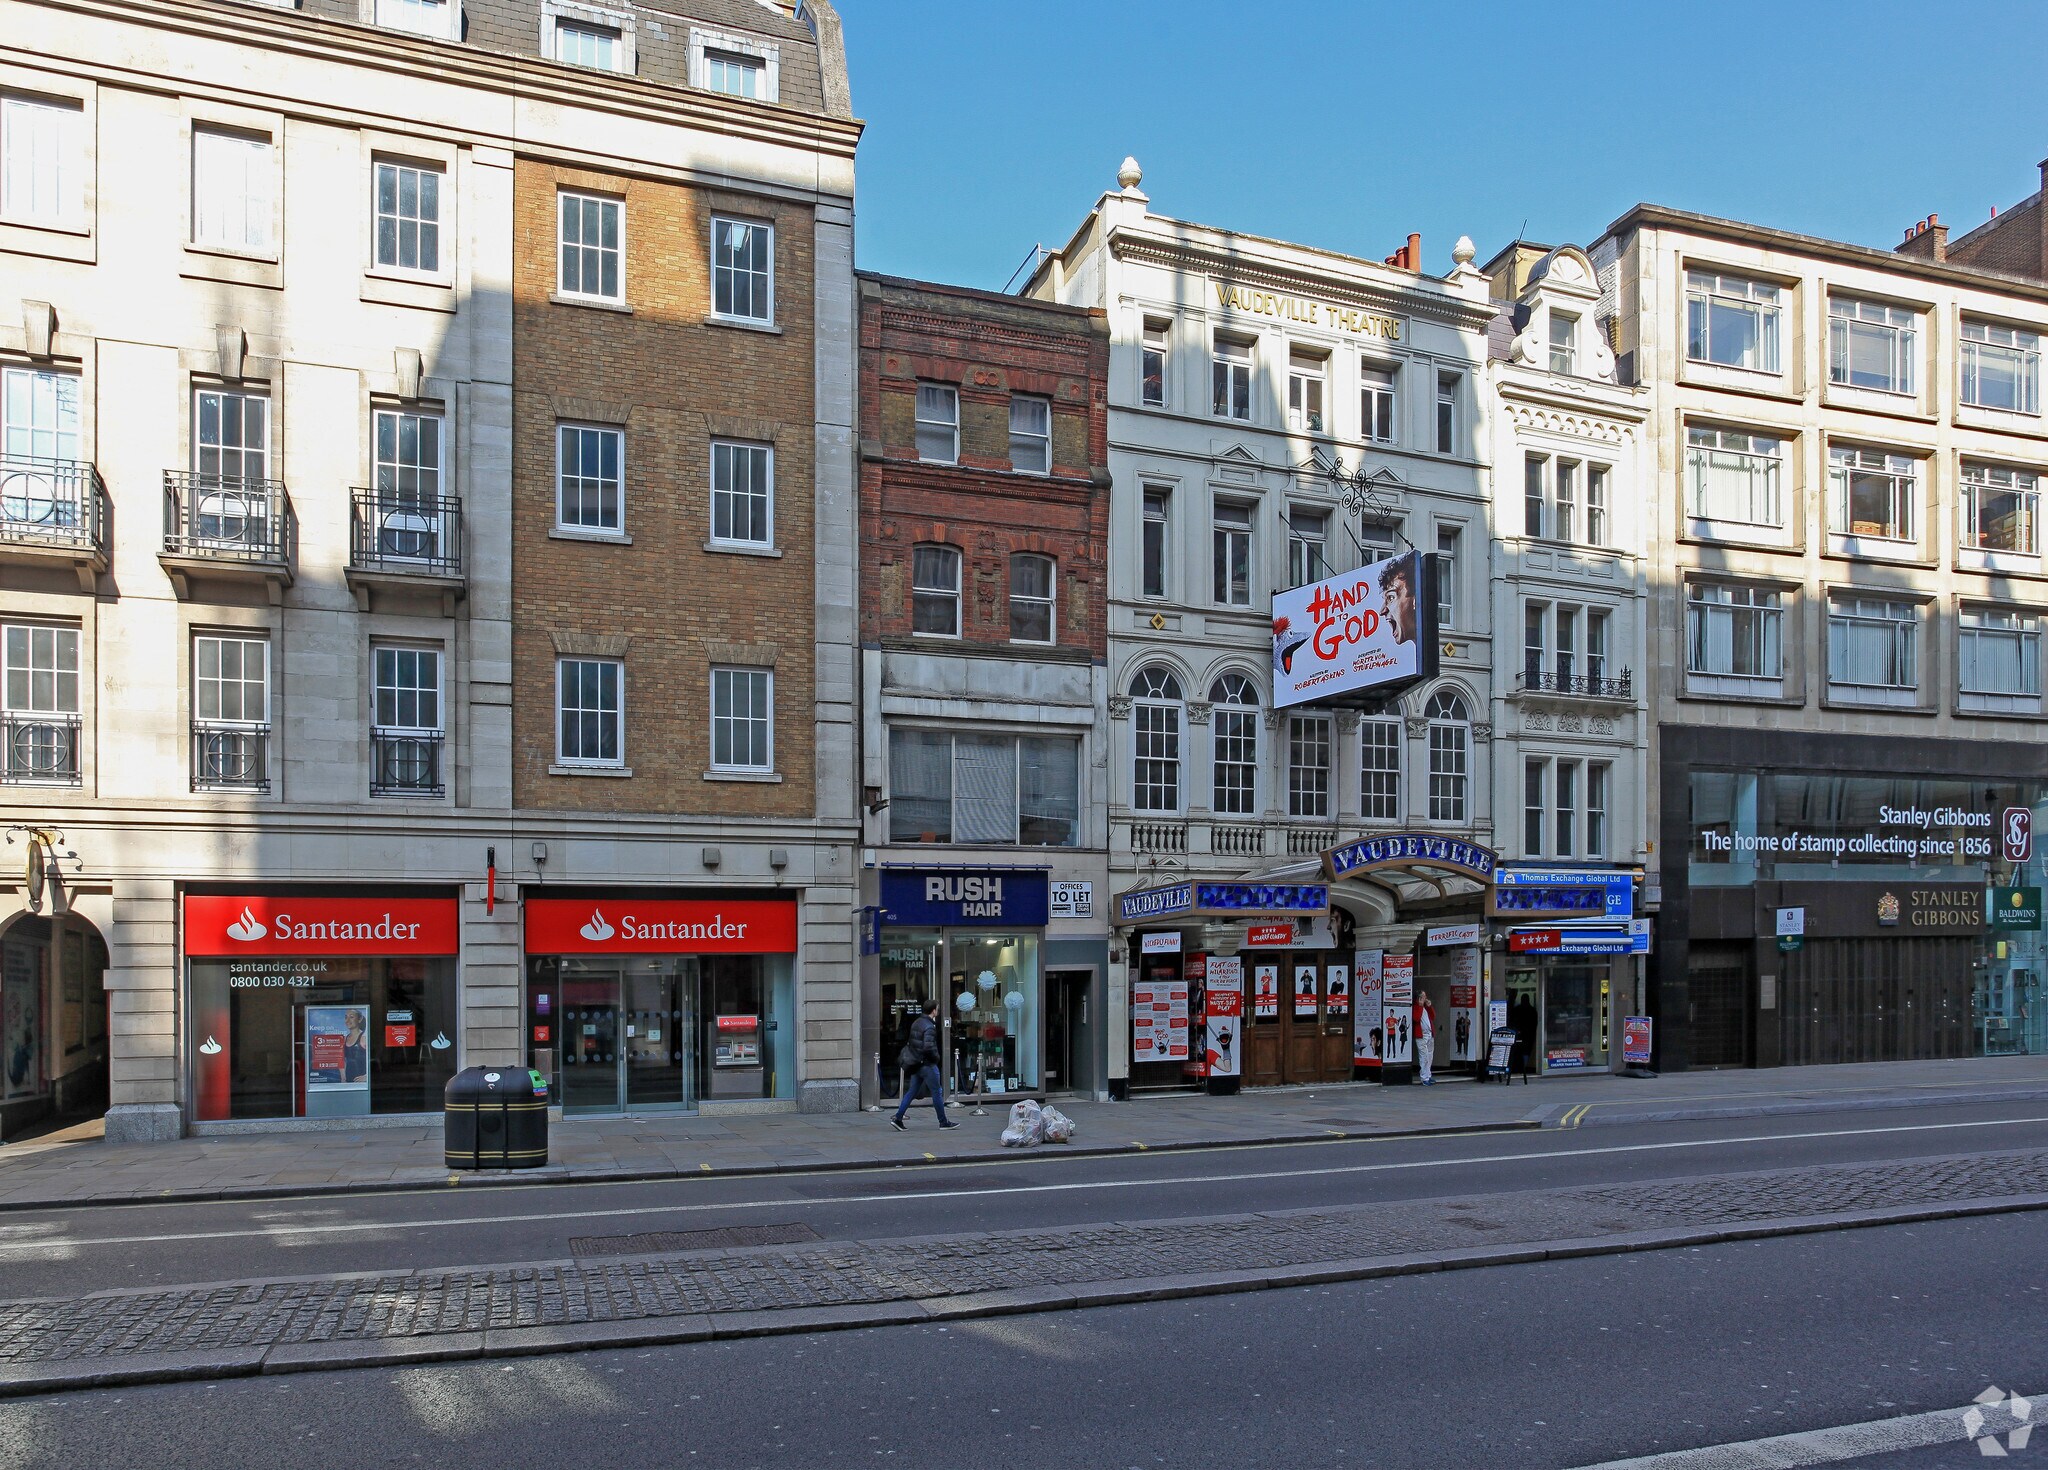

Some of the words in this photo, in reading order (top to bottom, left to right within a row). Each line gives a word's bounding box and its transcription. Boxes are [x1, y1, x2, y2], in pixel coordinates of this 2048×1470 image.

[1216, 283, 1318, 324] VAUDEVILLE
[1326, 306, 1401, 341] THEATRE
[1306, 582, 1369, 624] HAND
[1337, 613, 1348, 622] TO
[1313, 609, 1379, 660] GOD
[1375, 653, 1386, 661] VON
[1294, 676, 1321, 691] ROBERT
[1320, 669, 1345, 683] ASKINS
[1879, 805, 1931, 829] Stanley
[1934, 807, 1991, 827] Gibbons
[1702, 831, 1731, 850] The
[1735, 831, 1778, 851] home
[1782, 832, 1799, 851] of
[1800, 835, 1845, 856] stamp
[1849, 834, 1917, 858] collecting
[1920, 836, 1954, 854] since
[1958, 838, 1991, 855] 1856
[1335, 837, 1491, 873] VAUDEVILLE
[1521, 874, 1548, 882] Thomas
[1551, 874, 1584, 884] Exchange
[1586, 874, 1607, 883] Global
[1610, 874, 1621, 883] Ltd
[926, 877, 1002, 901] RUSH
[1052, 891, 1068, 902] TO
[1073, 891, 1090, 902] LET
[1123, 887, 1191, 915] VAUDEVILLE
[1911, 891, 1979, 906] STANLEY
[962, 903, 1002, 917] HAIR
[1912, 910, 1980, 926] GIBBONS
[1999, 909, 2036, 918] BALDWIN'S
[275, 913, 420, 940] Santander
[621, 914, 747, 939] Santander
[1430, 930, 1458, 942] TERRIFIC
[1458, 930, 1475, 938] CAST
[888, 949, 923, 960] RUSH
[1561, 944, 1592, 953] Exchange
[1592, 944, 1612, 952] Global
[1613, 944, 1623, 952] Ltd
[230, 961, 327, 972] santander.co.uk
[1356, 965, 1376, 981] HAND
[230, 977, 260, 988] 0800
[263, 977, 284, 988] 030
[288, 976, 315, 987] 4321
[1361, 978, 1381, 995] GOD
